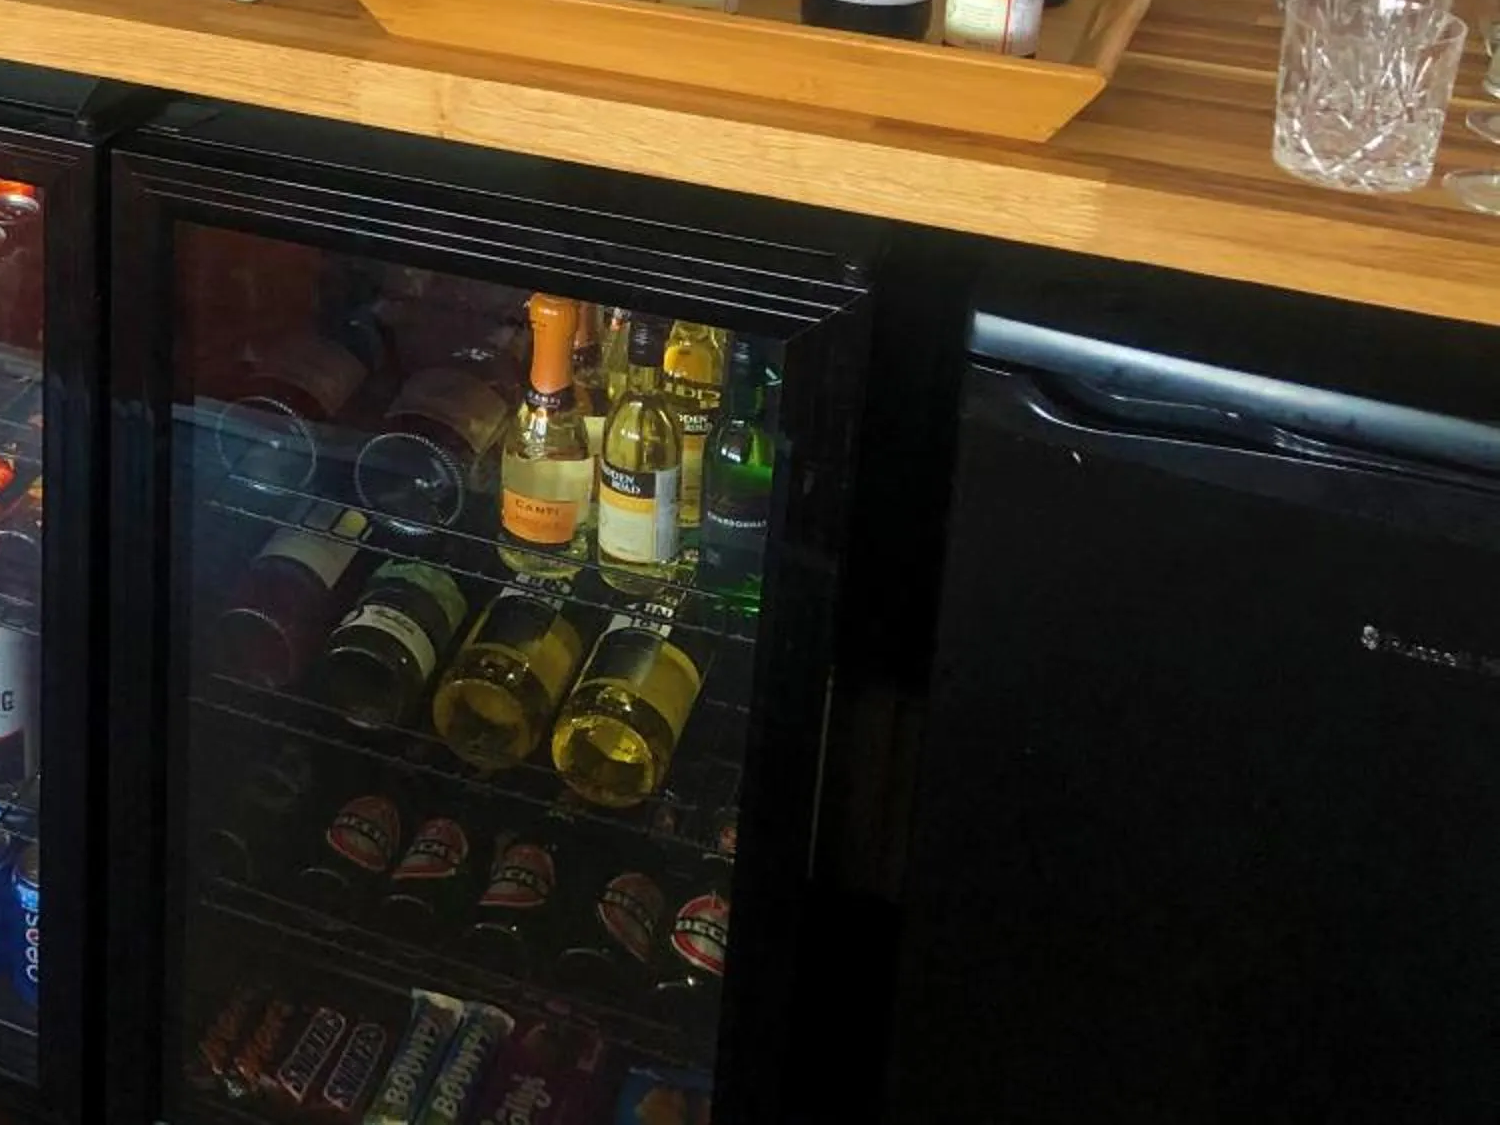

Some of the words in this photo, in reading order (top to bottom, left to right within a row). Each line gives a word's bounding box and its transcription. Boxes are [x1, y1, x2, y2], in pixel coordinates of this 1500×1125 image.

[515, 498, 560, 517] CANTI
[386, 1017, 442, 1106] BOUNTY
[431, 1031, 488, 1119] BOUNTY
